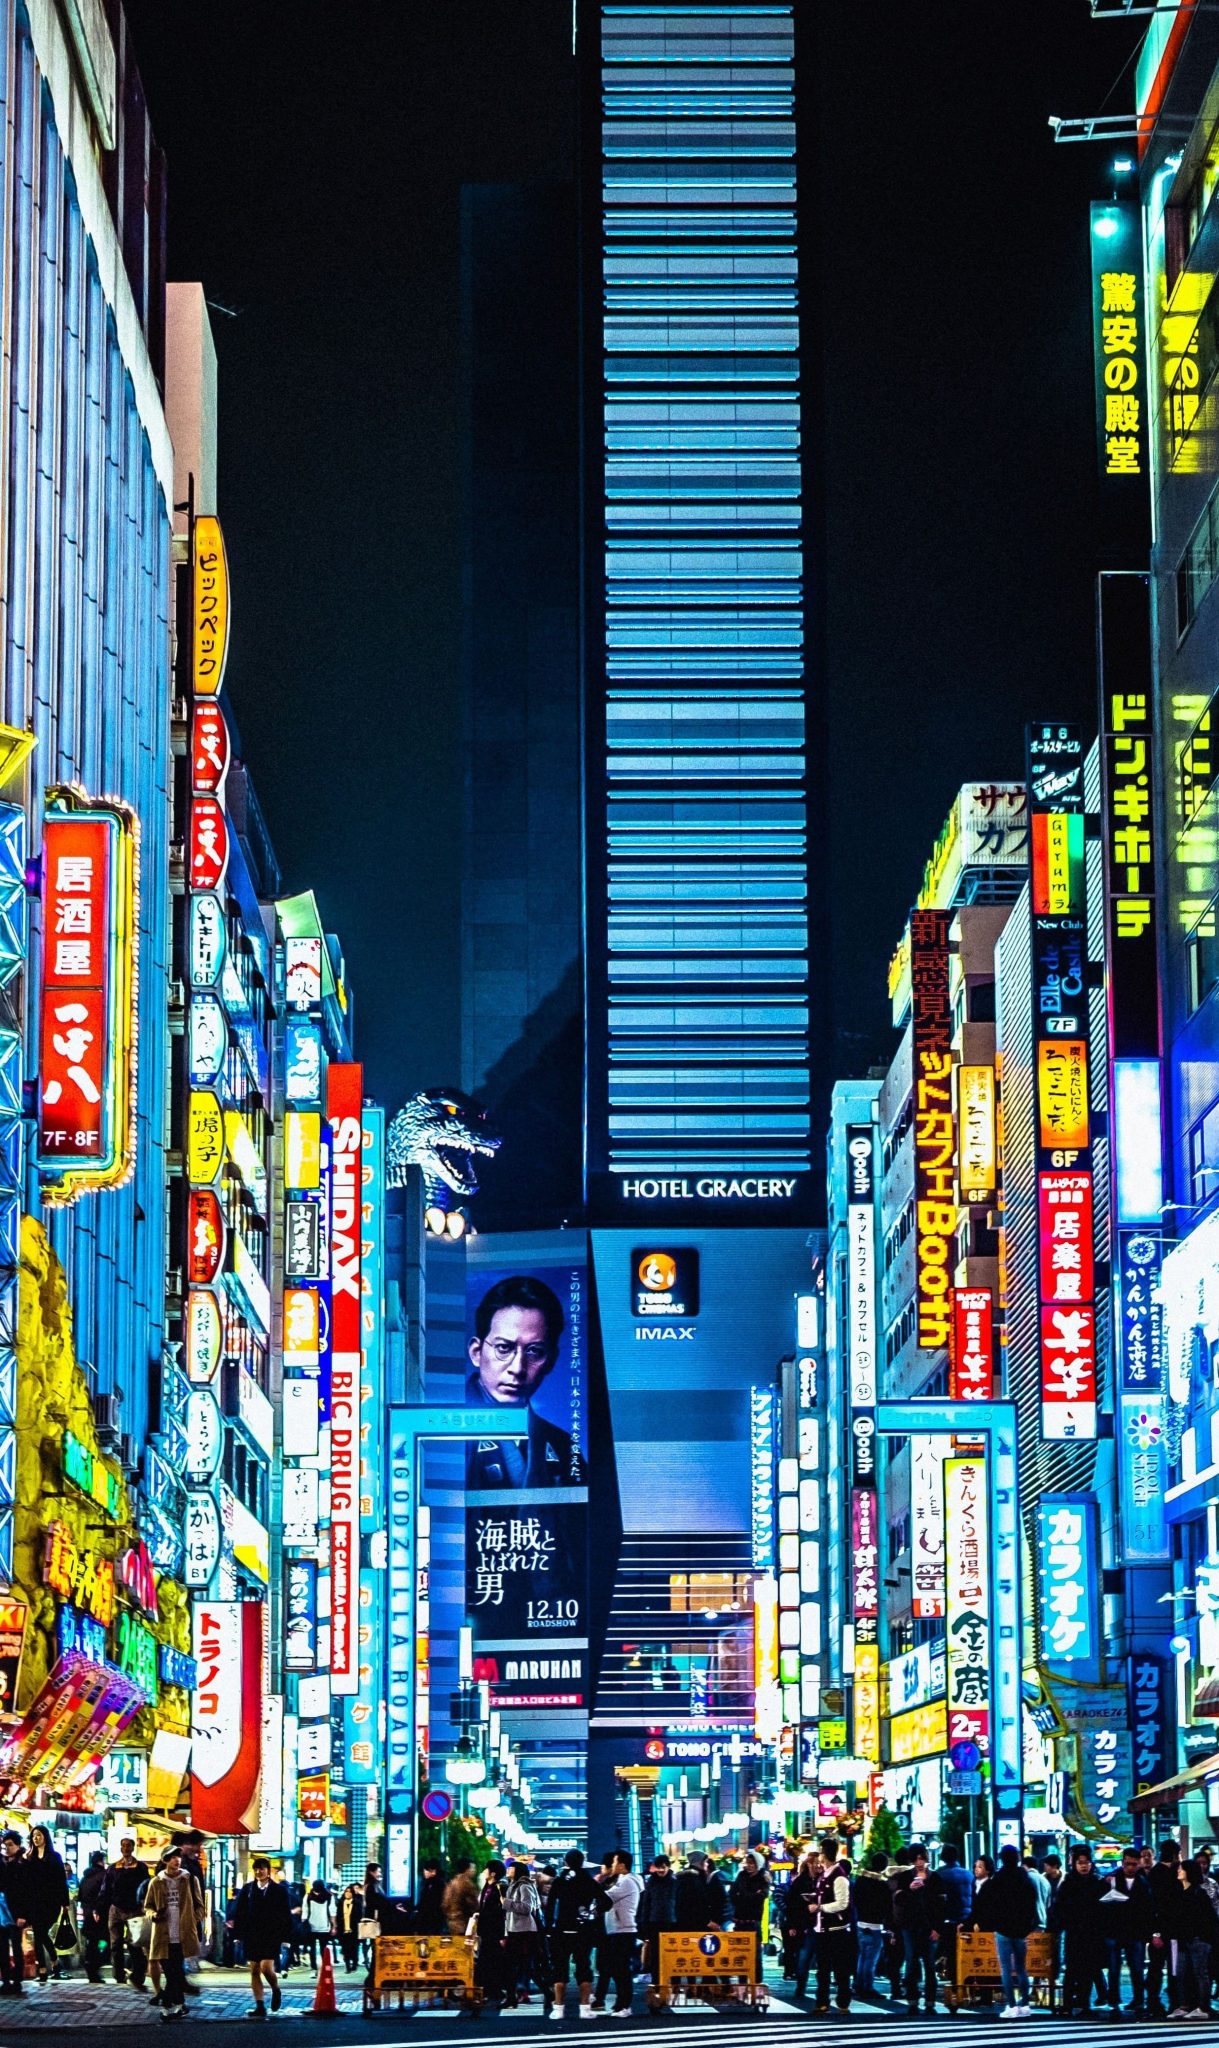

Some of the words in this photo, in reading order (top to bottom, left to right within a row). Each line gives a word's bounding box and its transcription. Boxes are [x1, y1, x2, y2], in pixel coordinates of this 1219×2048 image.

[1101, 272, 1140, 474] 驚安の殿堂
[196, 724, 222, 771] つぼ八
[1112, 694, 1150, 937] ドン・キホーテ
[194, 819, 222, 867] つぼ八
[195, 877, 214, 886] 7F
[54, 856, 93, 976] 居酒屋
[1036, 919, 1058, 929] New
[1060, 919, 1084, 929] Club
[1040, 945, 1059, 970] de
[193, 971, 215, 984] 6F
[1040, 974, 1061, 1014] Elle
[1050, 1020, 1073, 1031] 7F
[43, 1002, 100, 1105] つぼ八
[196, 1074, 211, 1083] 5F
[1051, 1150, 1079, 1168] 6F
[623, 1179, 694, 1198] HOTEL
[696, 1178, 797, 1198] GRACERY
[968, 1189, 988, 1202] 6F
[332, 1116, 361, 1300] SHIDAX
[638, 1292, 673, 1304] TOHO
[857, 1282, 867, 1293] &
[638, 1303, 685, 1314] CINEMAS
[635, 1327, 694, 1340] IMAX
[331, 1371, 353, 1419] BIC
[192, 1473, 208, 1482] 1F
[331, 1429, 352, 1511] DRUG
[1133, 1453, 1147, 1507] STAGE
[1147, 1453, 1159, 1496] IDOL
[474, 1518, 557, 1552] 海賊と
[1134, 1524, 1157, 1540] 5F
[392, 1467, 411, 1647] GODZILLA
[474, 1552, 550, 1573] よばれた
[191, 1568, 209, 1579] B1
[853, 1544, 878, 1609] 甘太郎
[1048, 1508, 1086, 1653] カラオケ
[474, 1573, 505, 1606] 男
[526, 1599, 579, 1620] 12.10
[527, 1618, 578, 1628] ROADSHOW
[857, 1617, 877, 1629] 4F
[856, 1630, 876, 1642] 3F
[198, 1612, 222, 1715] トラノコ
[951, 1610, 989, 1704] 金の蔵
[505, 1660, 582, 1680] MARUHAN
[392, 1670, 410, 1757] ROAD
[951, 1713, 981, 1738] 2F
[1135, 1662, 1161, 1777] カラオケ
[666, 1742, 711, 1757] TOHO
[1094, 1729, 1121, 1824] カラオケ
